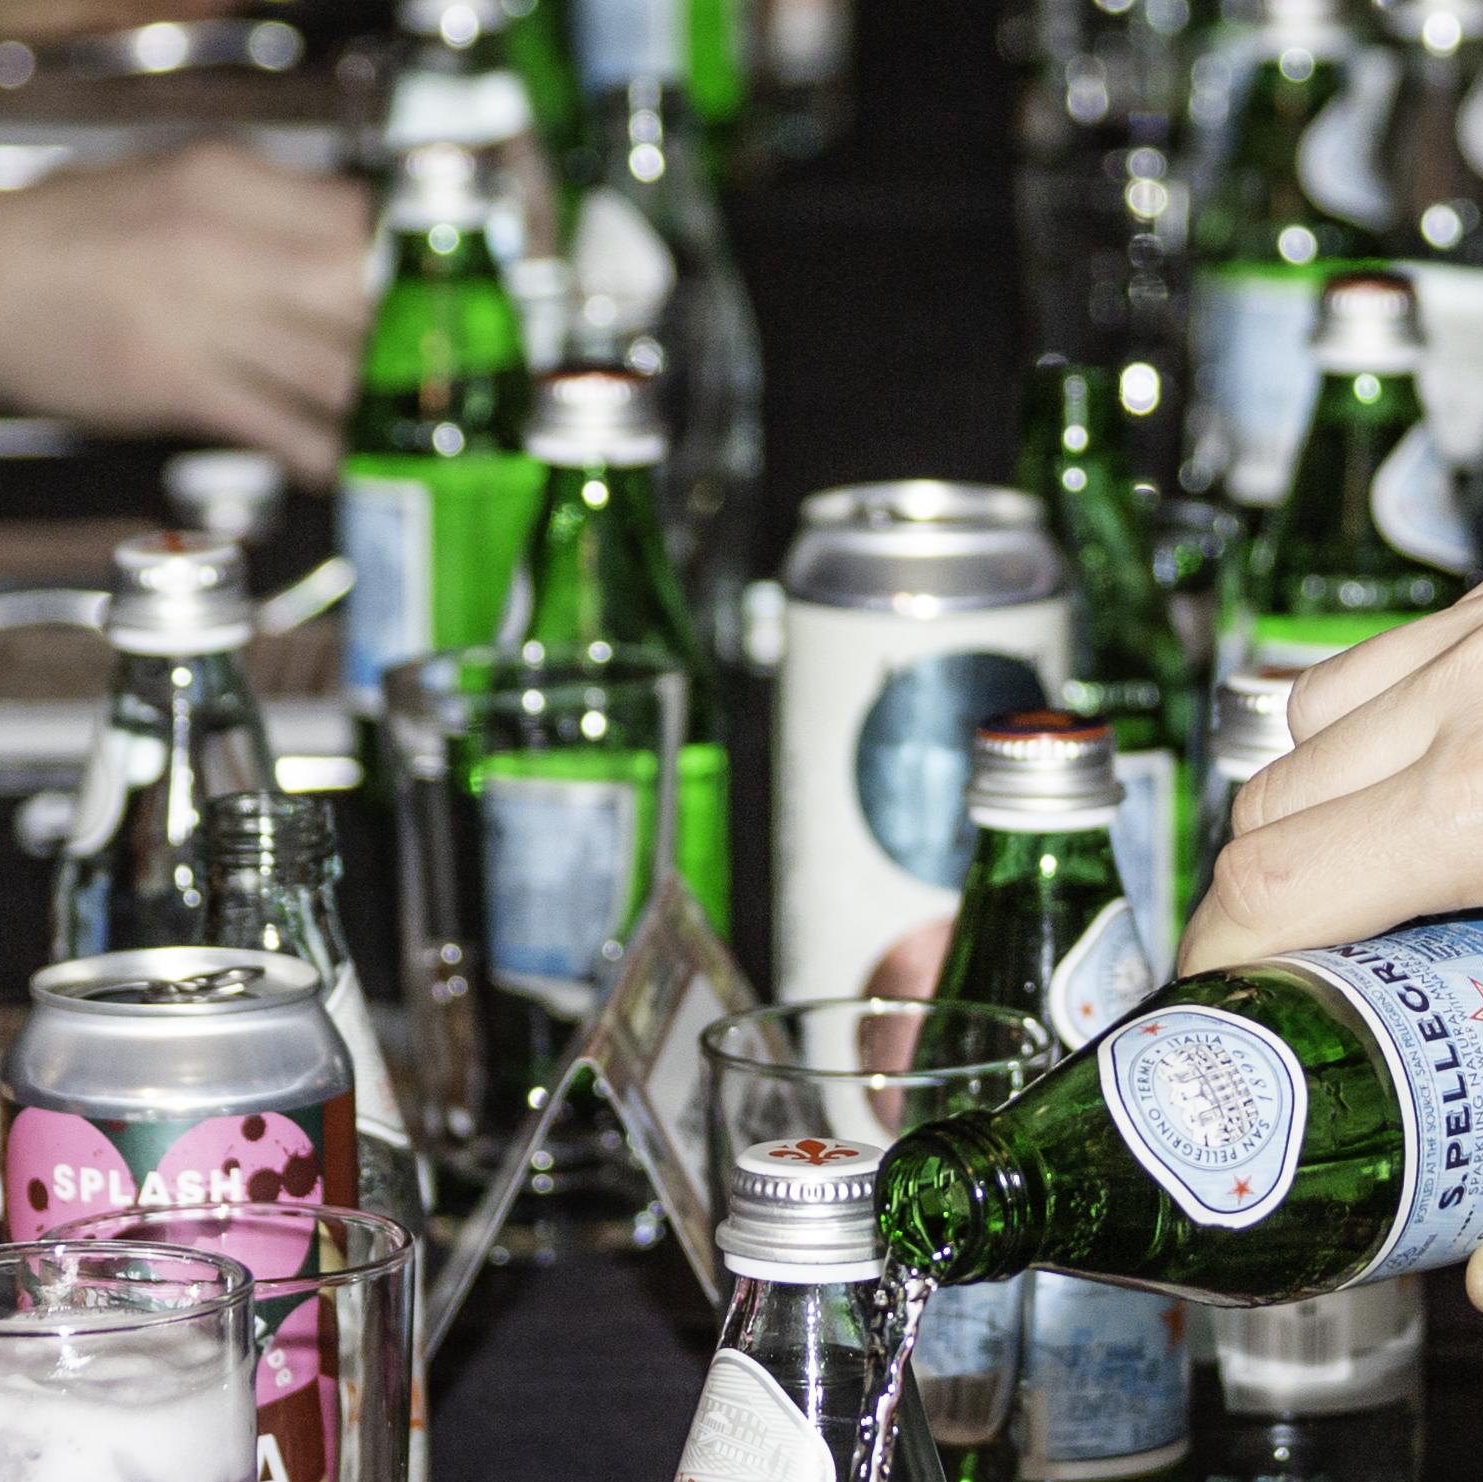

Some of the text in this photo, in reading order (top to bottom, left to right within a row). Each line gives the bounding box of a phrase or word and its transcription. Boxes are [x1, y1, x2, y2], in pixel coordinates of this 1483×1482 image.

[1166, 1034, 1223, 1048] ITALIA
[1447, 1005, 1478, 1089] NATURAL
[1231, 1050, 1274, 1101] 1899
[1135, 1056, 1271, 1164] SAN PELLEGRINO TERME
[52, 1162, 242, 1206] SPLASH
